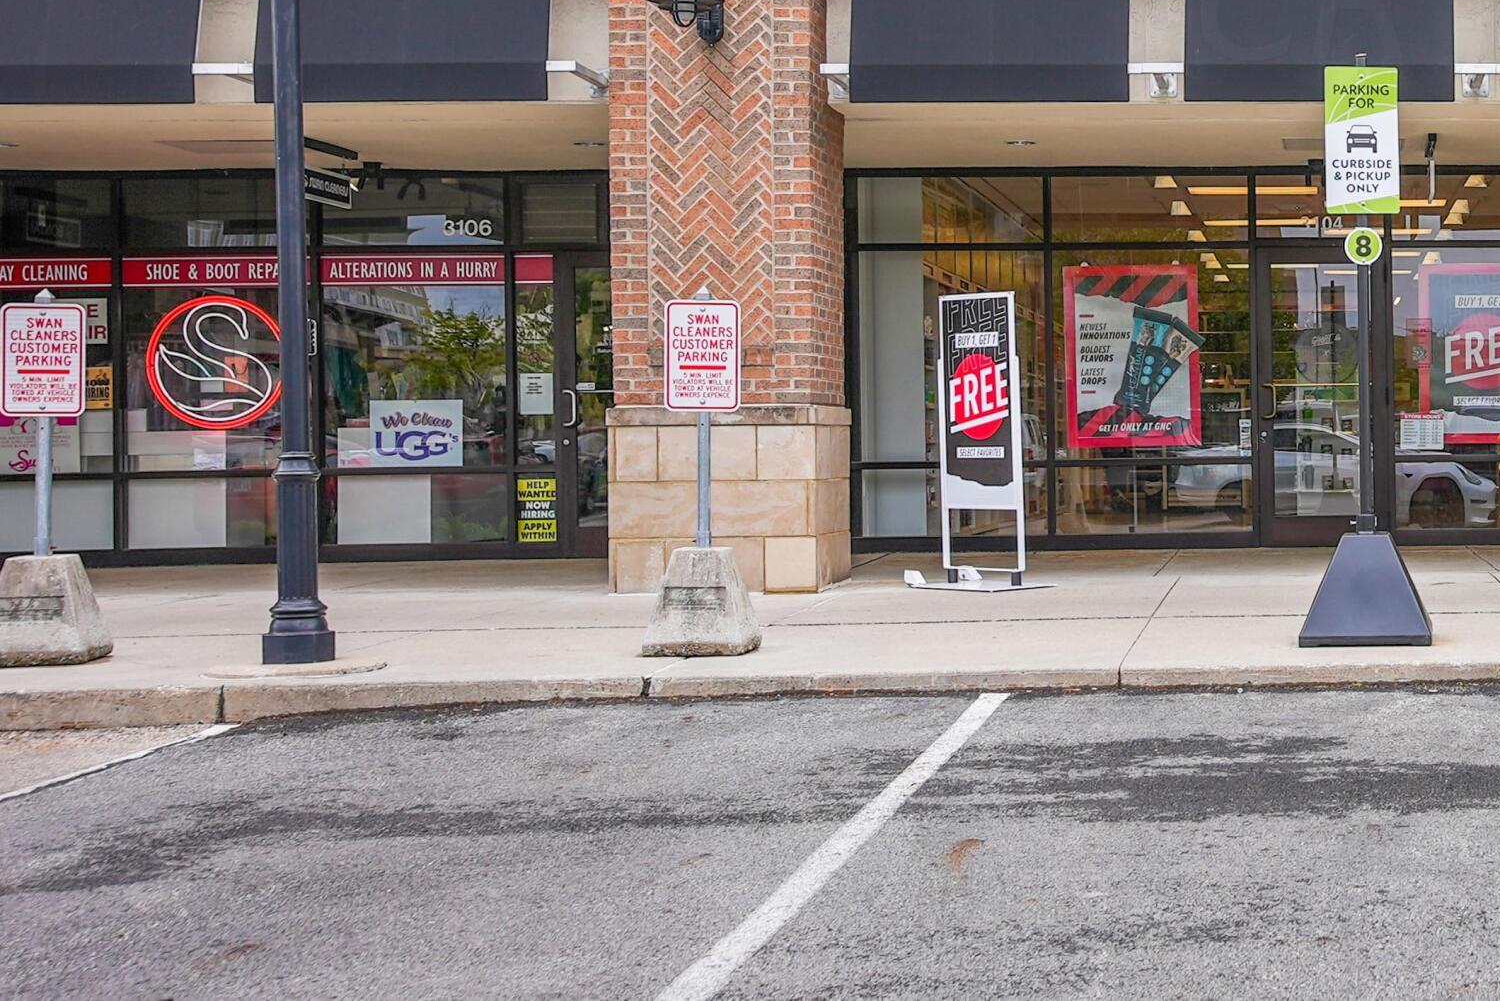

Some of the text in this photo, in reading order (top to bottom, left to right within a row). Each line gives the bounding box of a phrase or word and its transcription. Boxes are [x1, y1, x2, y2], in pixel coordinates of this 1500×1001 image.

[1333, 84, 1389, 96] PARKING
[1348, 98, 1375, 109] FOR
[1332, 159, 1392, 169] CURBSIDE
[1334, 171, 1391, 181] & PICKUP
[1346, 183, 1380, 193] ONLY
[443, 219, 493, 237] 3106
[1301, 216, 1343, 230] 3104
[1356, 235, 1372, 257] 8
[0, 263, 88, 281] AY CLEANING
[146, 262, 279, 280] SHOE & BOOT REPA
[329, 261, 498, 279] ALTERATIONS IN A HURRY
[1457, 297, 1476, 307] BUY
[1478, 297, 1485, 308] 1,
[26, 317, 63, 329] SWAN
[687, 313, 719, 325] SWAN
[673, 326, 733, 337] CLEANERS
[1079, 323, 1107, 331] NEWEST
[10, 330, 77, 341] CLEANERS
[957, 333, 997, 347] BUY 1, GET 1
[1079, 331, 1131, 340] INNOVATIONS
[10, 342, 78, 354] CUSTOMER
[672, 338, 733, 350] CUSTOMER
[1080, 345, 1111, 354] BOLDEST
[15, 355, 72, 367] PARKING
[677, 351, 728, 362] PARKING
[1080, 354, 1114, 363] FLAVORS
[1081, 368, 1105, 376] LATEST
[1081, 377, 1107, 385] DROPS
[949, 361, 1009, 424] FREE
[380, 411, 454, 429] We Clean
[1099, 421, 1172, 432] GET IT ONLY AT GNC
[375, 430, 459, 461] UGG's
[959, 447, 1002, 457] SELECT FAVORITES
[526, 481, 550, 489] HELP
[518, 489, 557, 498] WANTED
[525, 501, 551, 510] NOW
[520, 510, 556, 519] HIRING
[523, 522, 553, 531] APPLY
[520, 531, 556, 540] WITHIN
